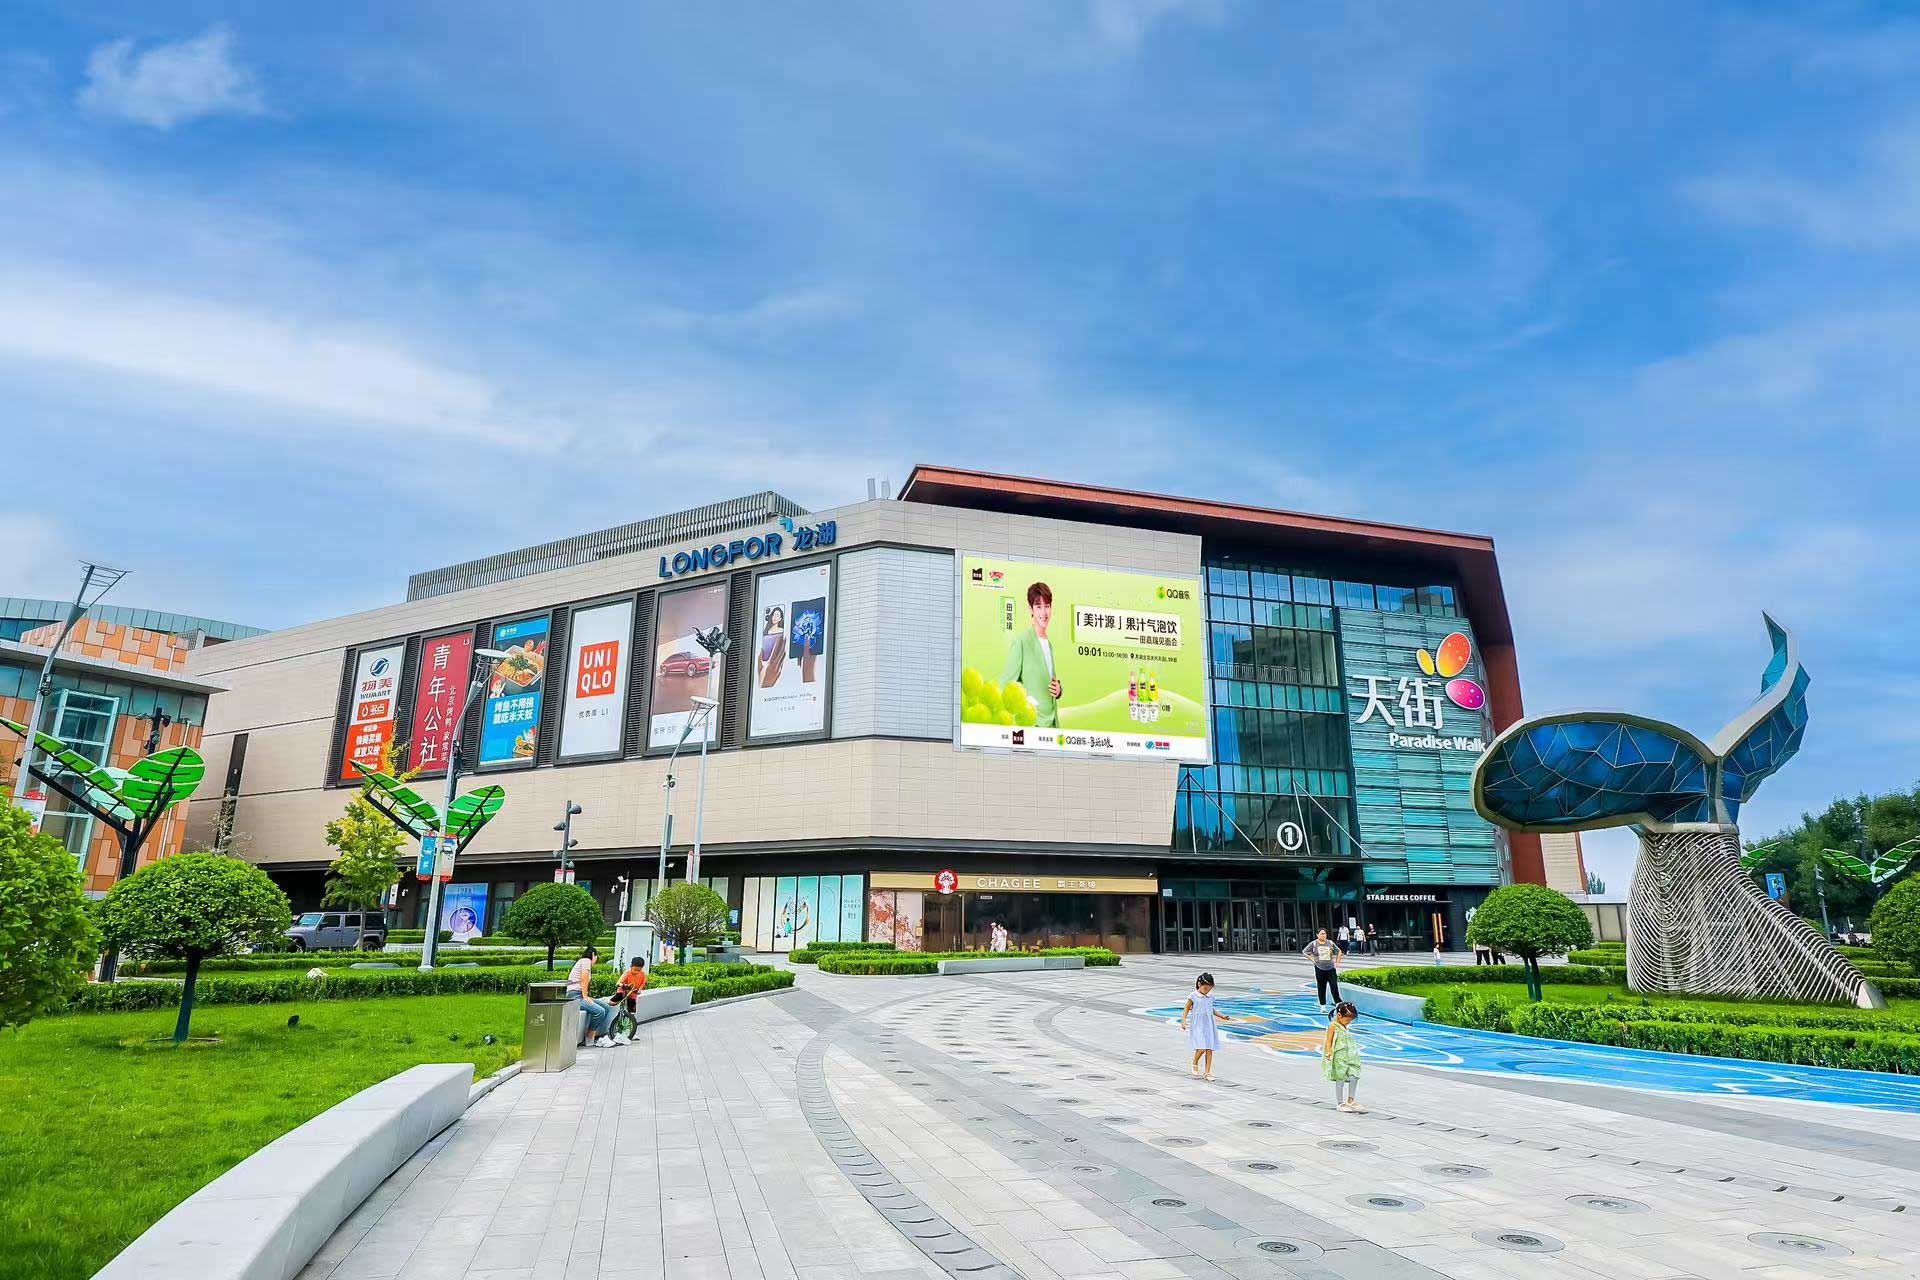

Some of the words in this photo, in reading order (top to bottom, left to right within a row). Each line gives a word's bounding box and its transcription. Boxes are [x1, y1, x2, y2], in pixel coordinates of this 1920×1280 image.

[792, 520, 837, 551] 龙湖
[659, 532, 783, 578] LONGFOR
[584, 648, 612, 670] UNI
[1078, 646, 1102, 657] 09:01
[361, 678, 393, 692] 物美
[581, 670, 612, 694] QLO
[419, 643, 451, 766] 青年公社
[1351, 674, 1444, 730] 天街
[1389, 732, 1452, 750] Paradise
[1453, 736, 1487, 752] Walk
[976, 877, 1040, 889] CHAGEE
